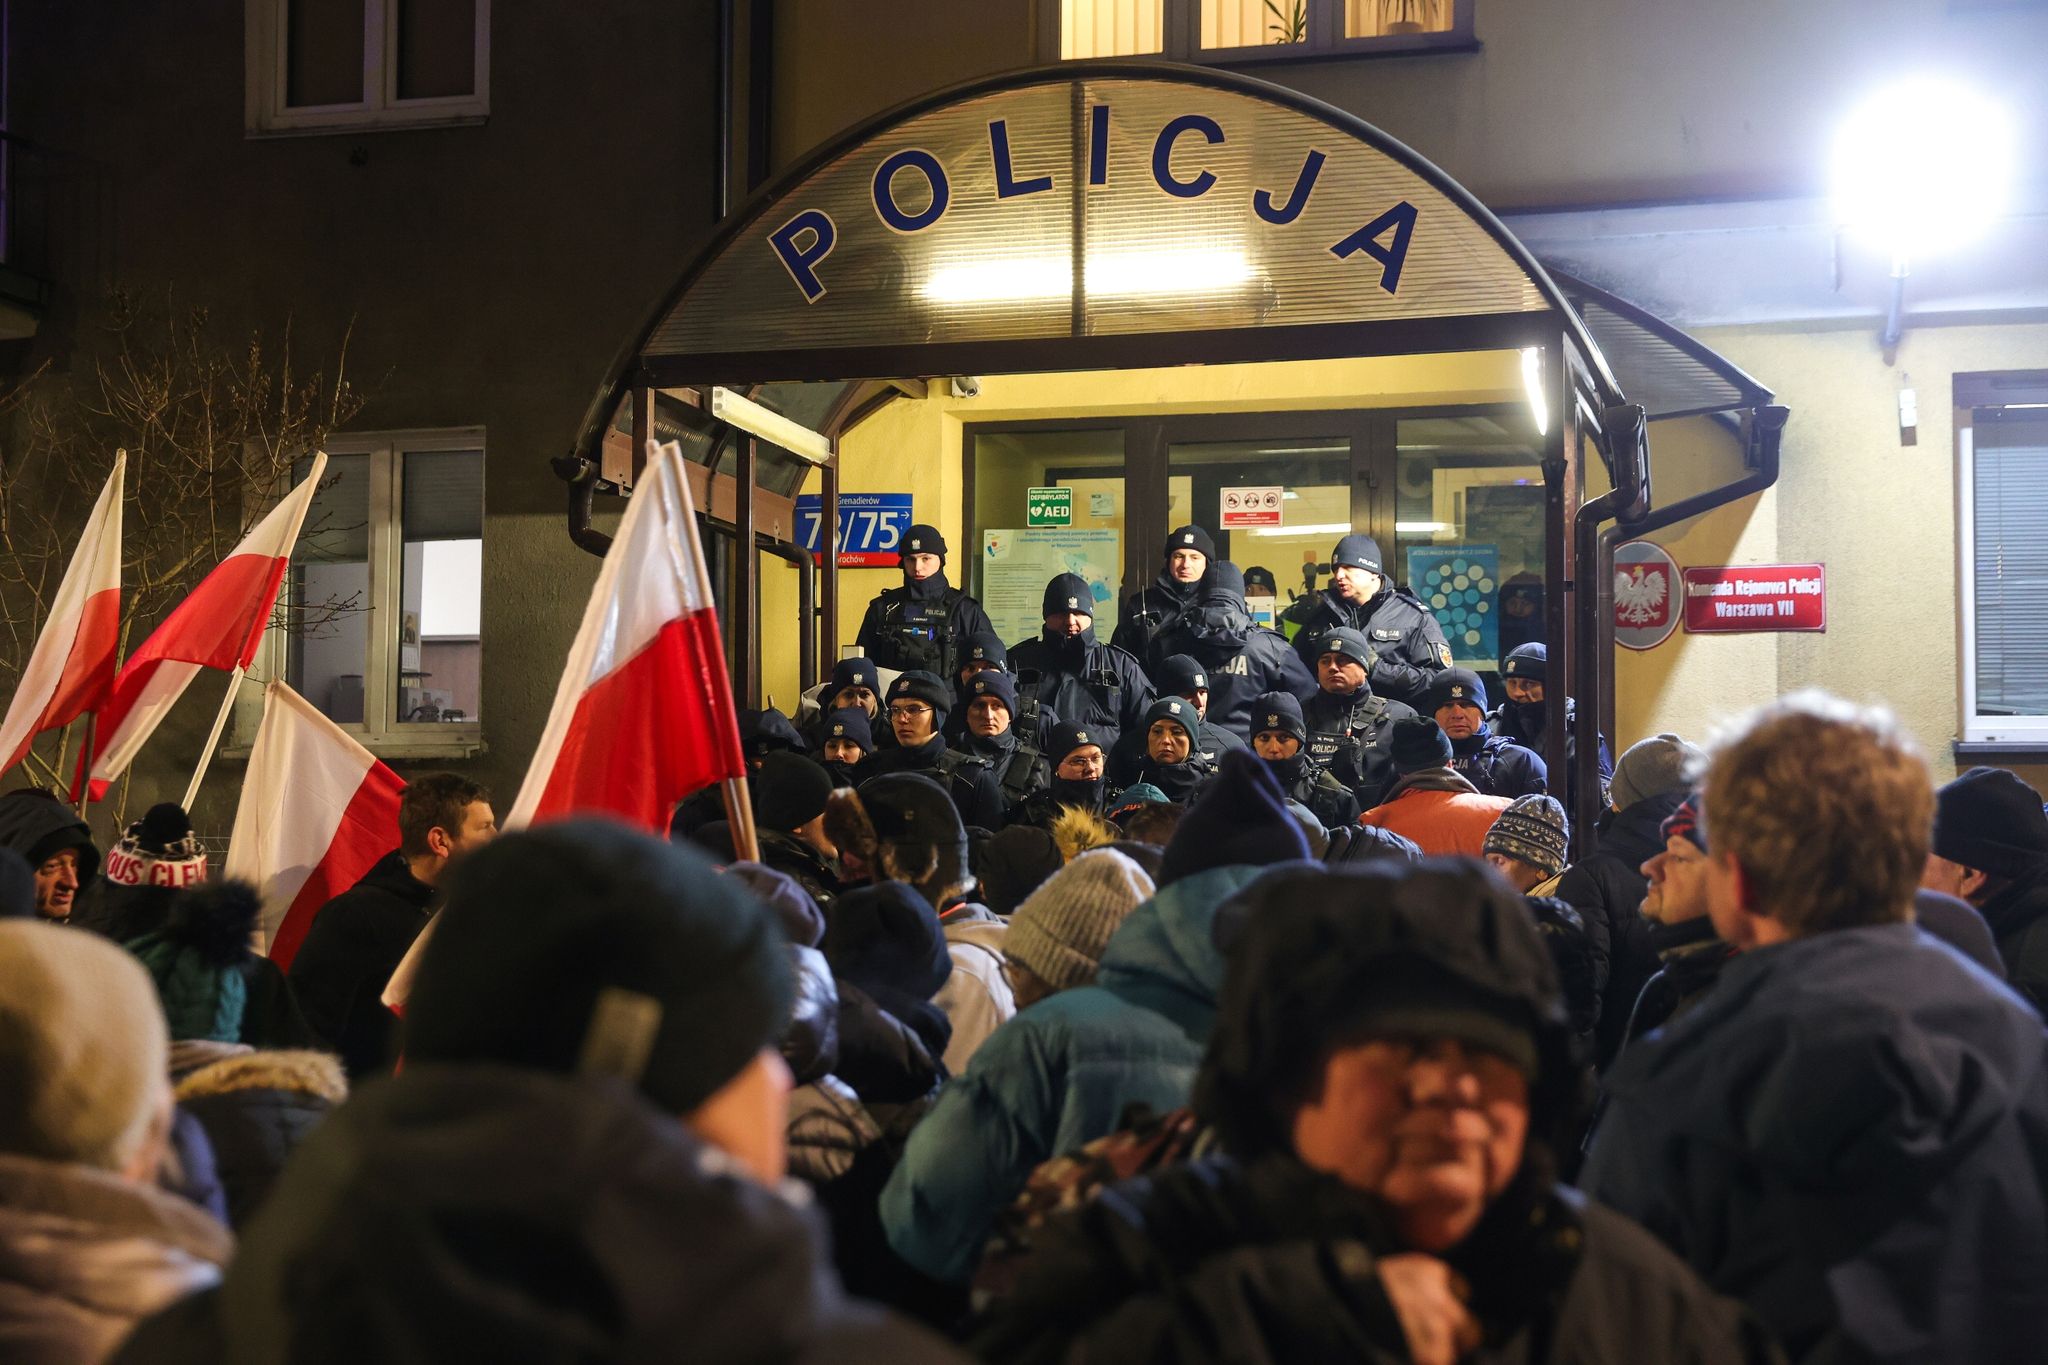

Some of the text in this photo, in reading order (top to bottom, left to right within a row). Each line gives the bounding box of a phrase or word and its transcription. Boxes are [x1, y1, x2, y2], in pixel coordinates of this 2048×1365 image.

[767, 104, 1419, 304] POLICJA
[1043, 506, 1070, 517] AED
[804, 511, 900, 553] 7/75
[1735, 580, 1786, 597] Rejonowa
[1788, 578, 1821, 595] Policji
[1715, 600, 1794, 617] Warszawa VII
